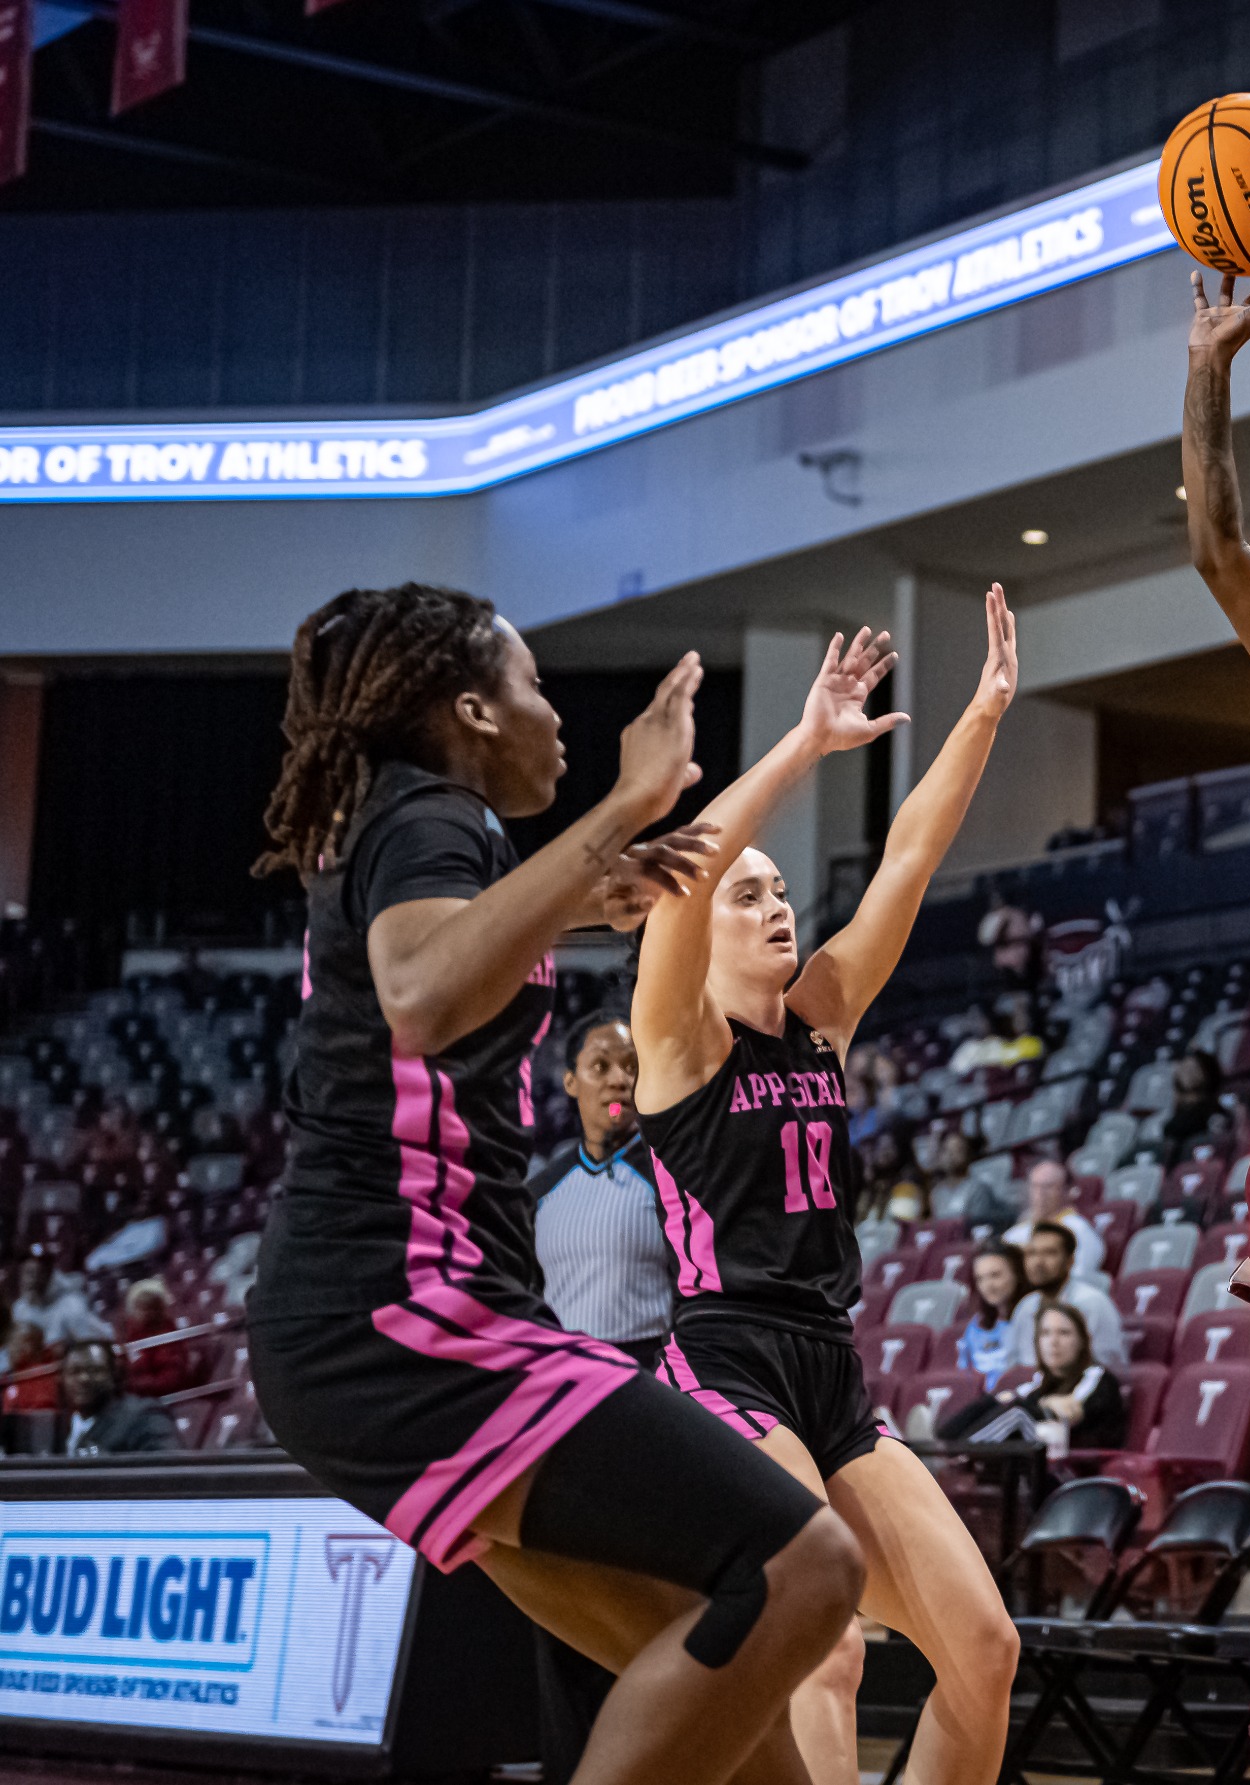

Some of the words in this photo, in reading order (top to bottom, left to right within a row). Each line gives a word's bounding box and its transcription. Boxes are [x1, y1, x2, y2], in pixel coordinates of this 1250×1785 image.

[45, 445, 101, 483] OF
[106, 442, 214, 482] TROY
[218, 438, 428, 480] ATHLETICS
[729, 1072, 786, 1113] APP
[780, 1121, 837, 1214] 10
[0, 1555, 99, 1637] BUD
[101, 1556, 257, 1643] LIGHT
